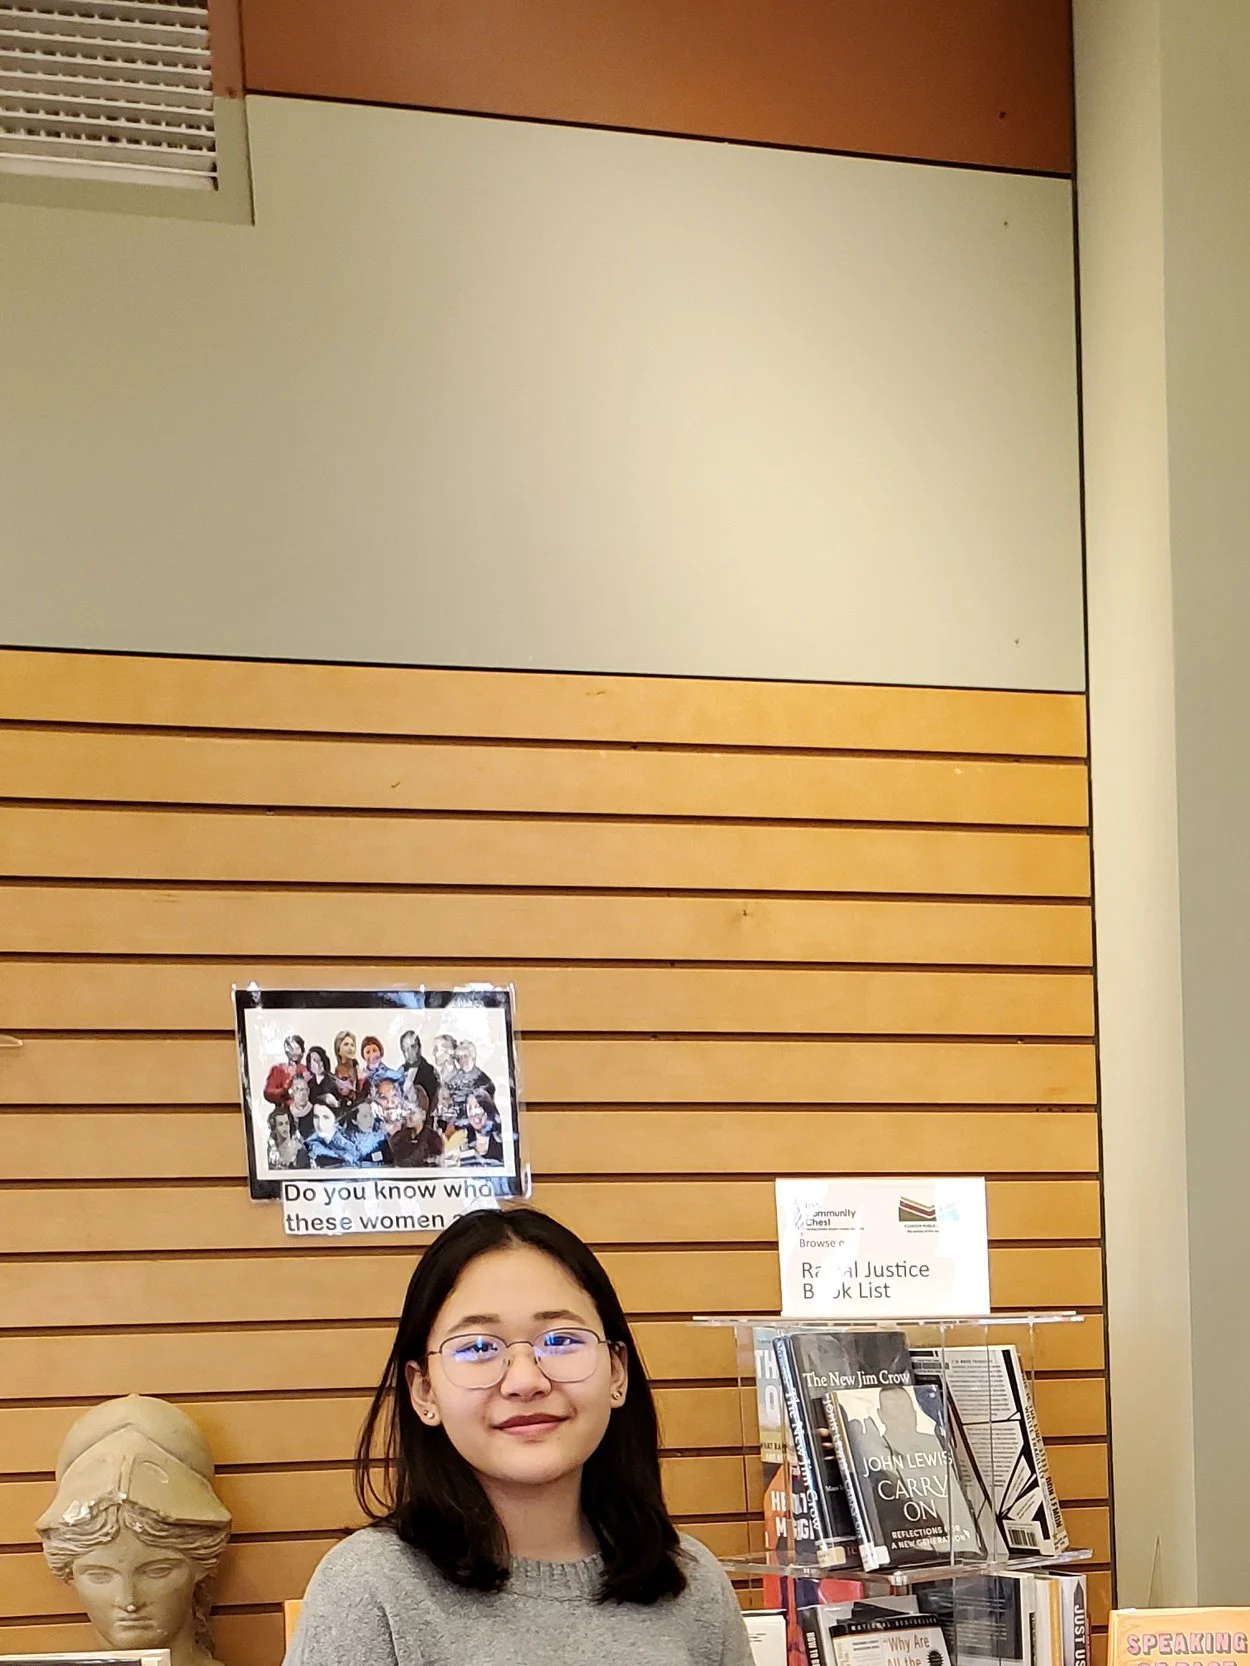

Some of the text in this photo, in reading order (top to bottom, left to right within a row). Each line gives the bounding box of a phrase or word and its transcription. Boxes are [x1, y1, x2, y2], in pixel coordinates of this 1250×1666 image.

[284, 1183, 317, 1202] Do
[324, 1185, 367, 1206] you
[374, 1180, 436, 1200] know
[285, 1213, 353, 1232] these
[360, 1214, 444, 1231] women
[799, 1239, 836, 1248] Browse
[864, 1260, 930, 1278] Justice
[859, 1282, 891, 1299] List
[803, 1369, 911, 1388] The New Jim Crow
[791, 1420, 807, 1456] New
[797, 1457, 813, 1486] Jim
[863, 1450, 953, 1478] JOHN LEWIS
[877, 1474, 949, 1502] CARRY
[805, 1488, 822, 1531] Crow
[903, 1499, 938, 1523] ON
[892, 1527, 943, 1540] REFLECTIONS
[891, 1541, 898, 1549] A
[899, 1539, 915, 1549] NEW
[851, 1617, 938, 1632] NATIONAL BESTSELLER
[1073, 1603, 1085, 1644] JUST
[806, 1632, 816, 1649] HOW
[913, 1634, 931, 1649] Are
[1127, 1632, 1248, 1656] SPEAKING
[808, 1649, 818, 1658] TO
